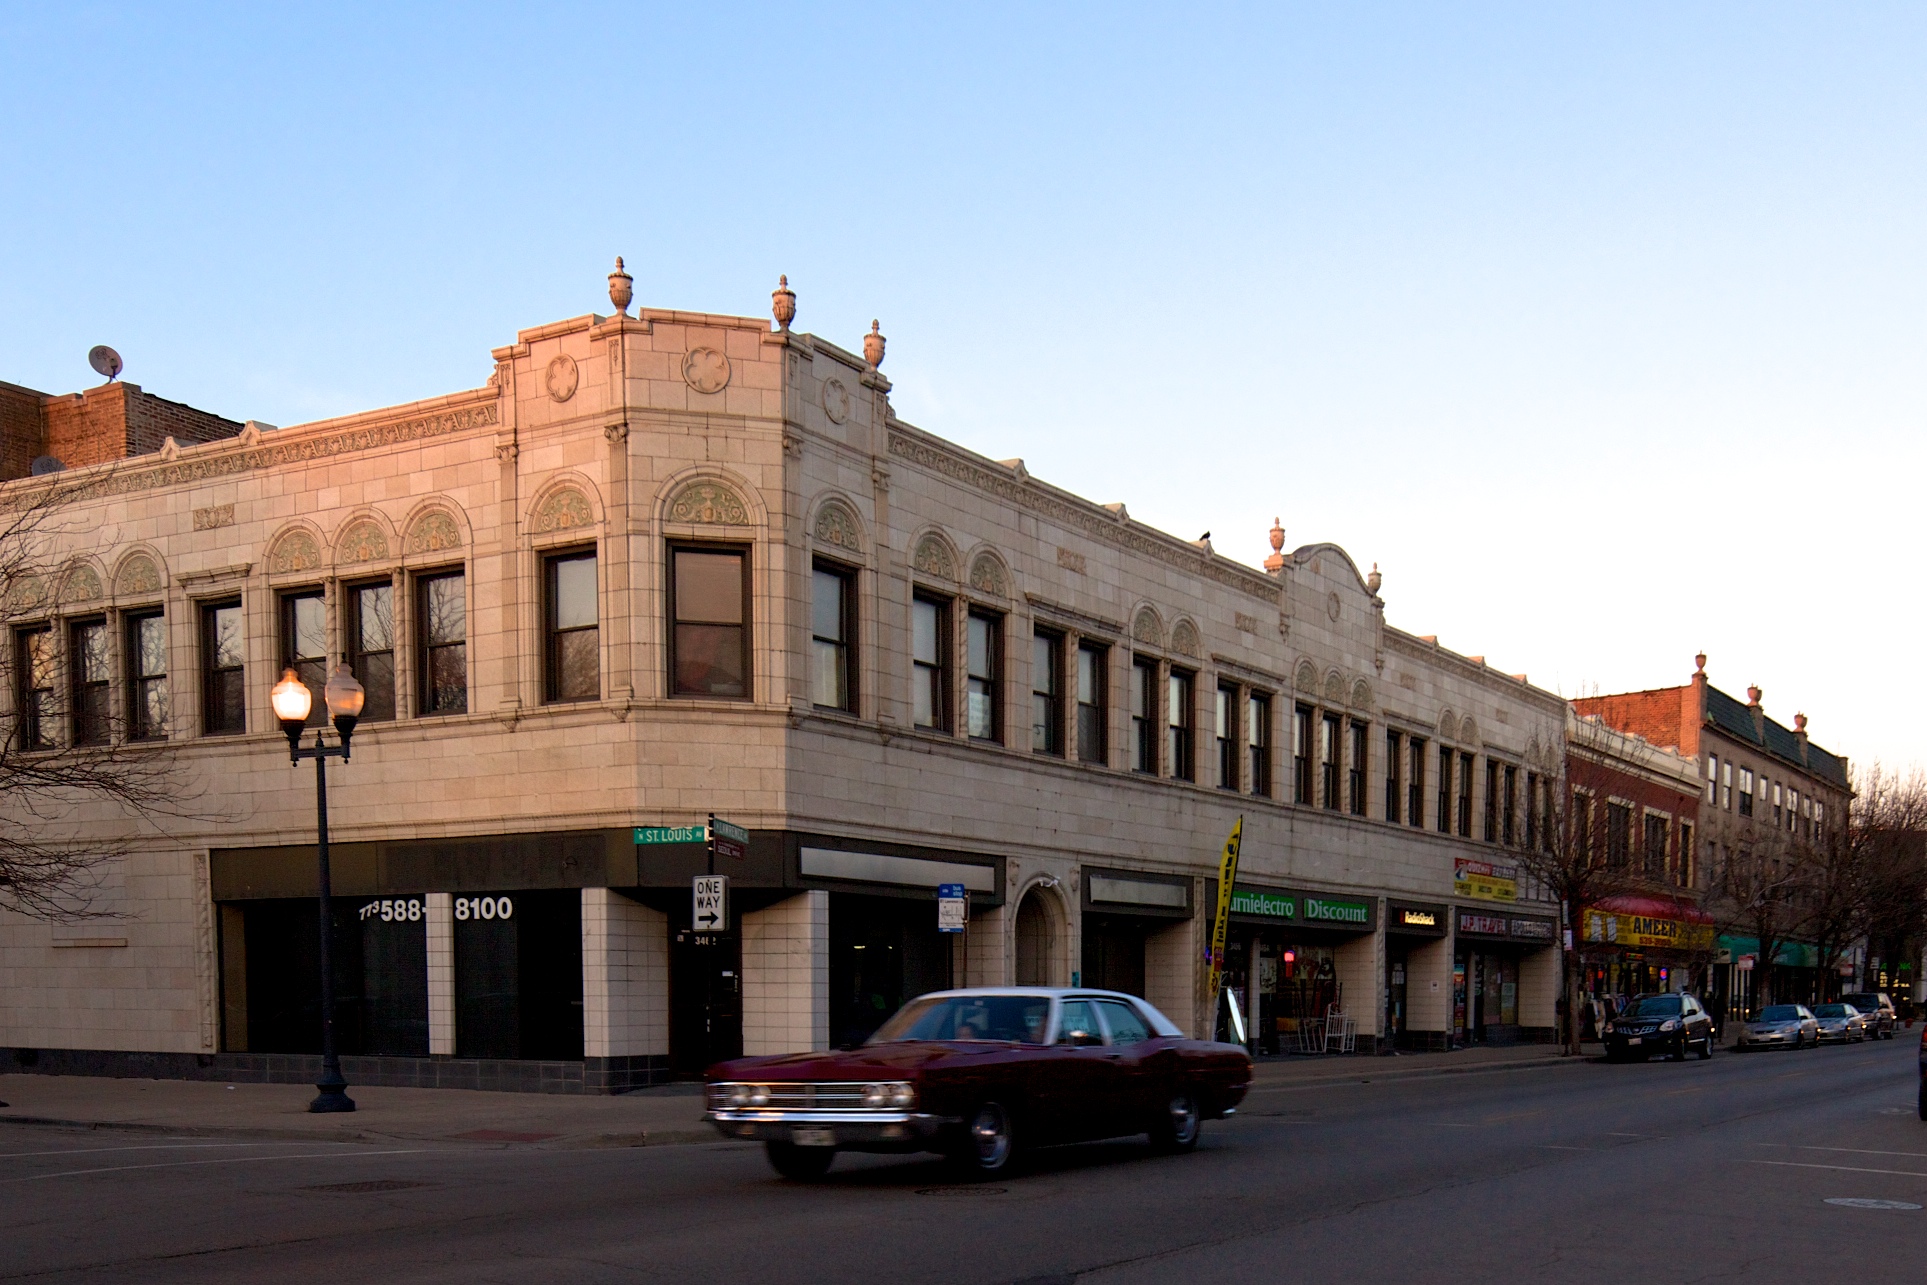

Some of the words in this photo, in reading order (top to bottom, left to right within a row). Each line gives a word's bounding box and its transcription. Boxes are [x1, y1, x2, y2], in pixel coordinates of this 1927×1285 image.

[646, 830, 659, 842] ST.
[662, 828, 693, 842] LOUIS
[697, 881, 720, 894] ONE
[358, 900, 380, 921] 773
[455, 896, 513, 921] 8100
[697, 896, 720, 909] WAY
[1230, 893, 1294, 916] urnielectro
[1308, 898, 1367, 922] Discount
[1633, 917, 1676, 937] AMEER
